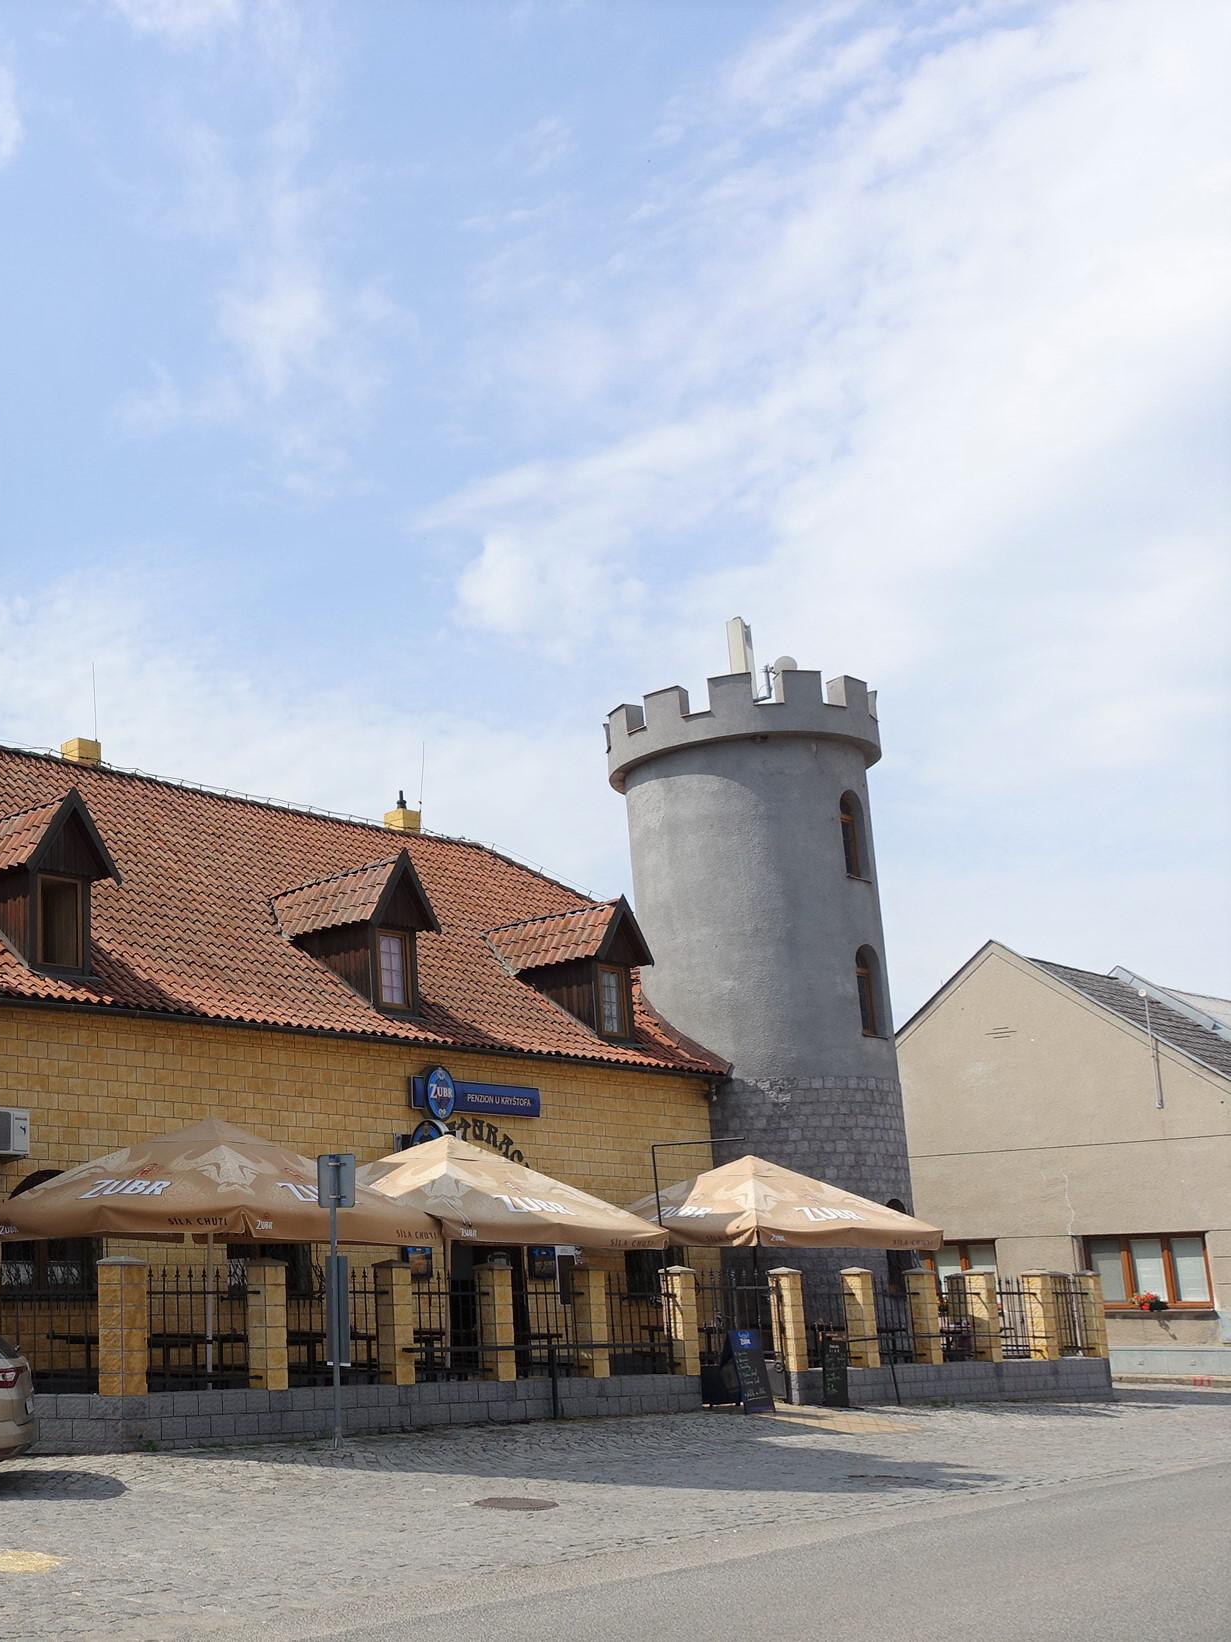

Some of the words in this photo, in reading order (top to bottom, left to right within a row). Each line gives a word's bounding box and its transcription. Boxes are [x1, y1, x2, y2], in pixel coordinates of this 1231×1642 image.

[467, 1093, 494, 1104] PENZION
[495, 1096, 500, 1105] U
[501, 1095, 531, 1107] KRYŠTOFA
[79, 1178, 172, 1199] ZUBR
[490, 1194, 577, 1216] ZUBR
